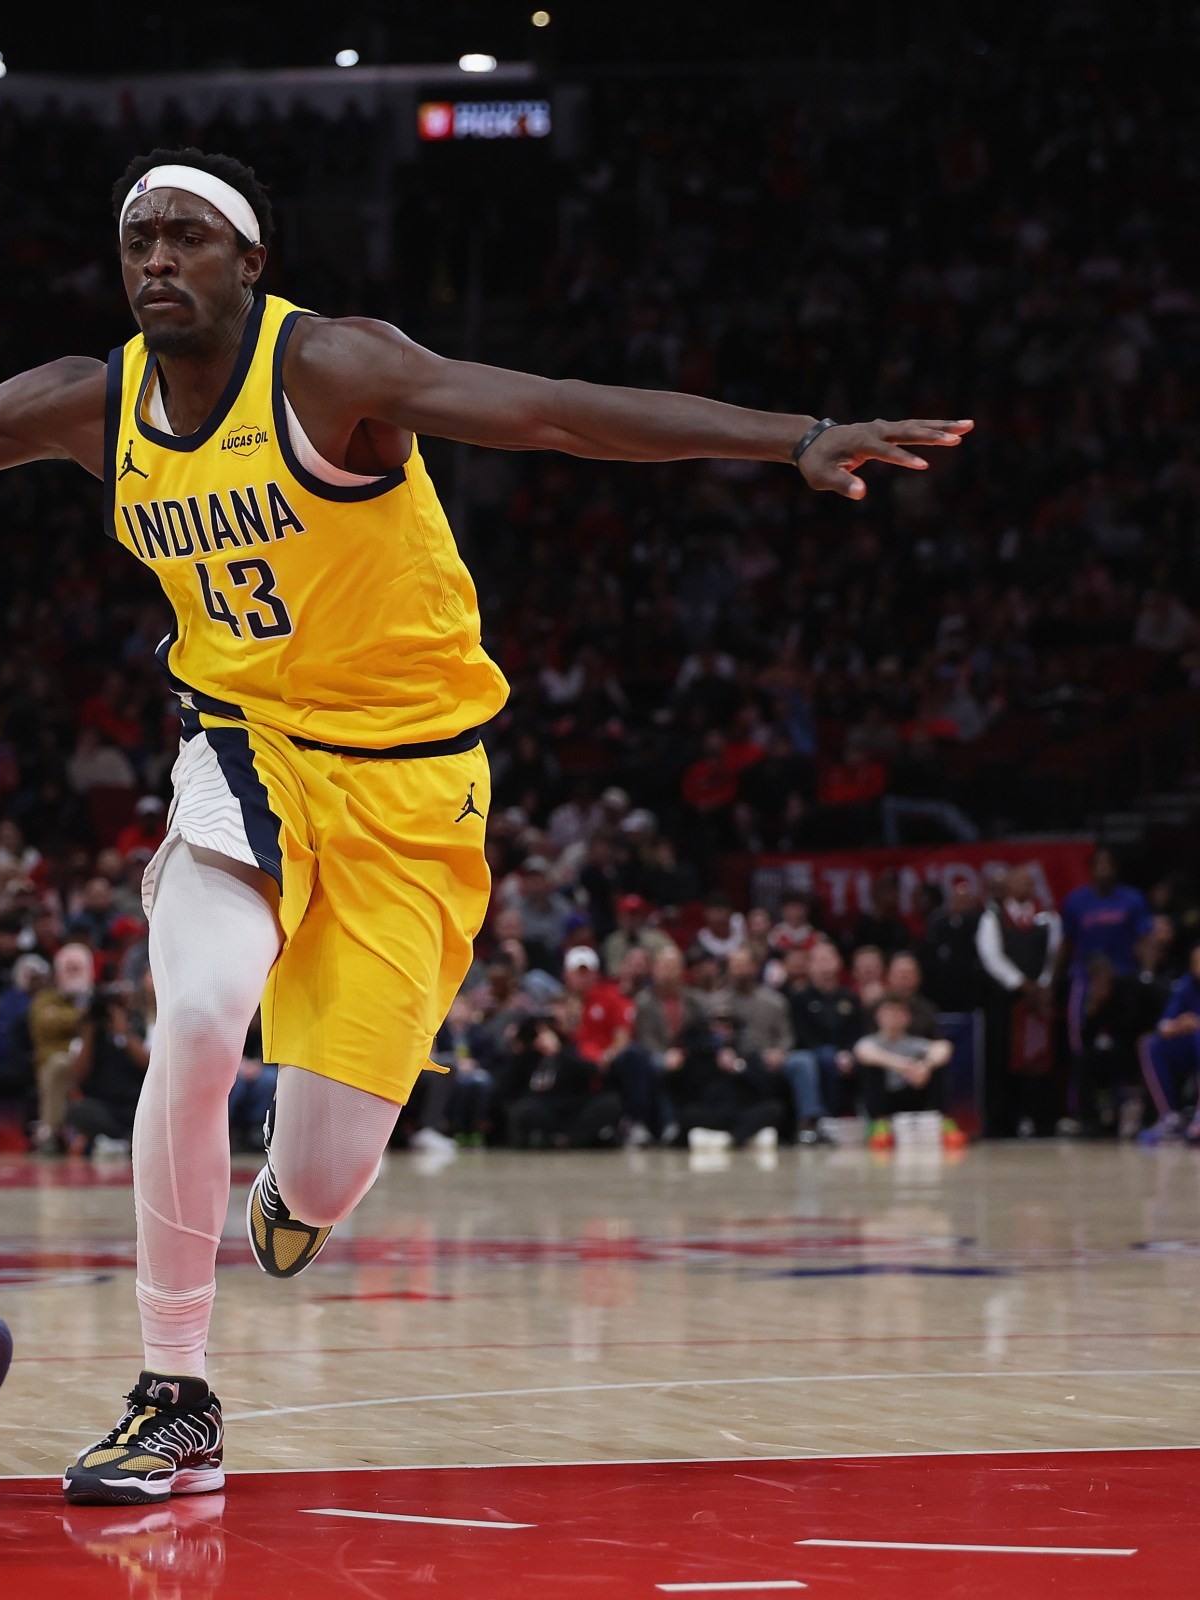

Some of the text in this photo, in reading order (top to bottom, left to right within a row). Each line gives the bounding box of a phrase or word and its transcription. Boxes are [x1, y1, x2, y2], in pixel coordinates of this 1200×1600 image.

[221, 430, 269, 451] LUCAS OIL
[121, 481, 309, 560] INDIANA
[194, 558, 295, 642] 43
